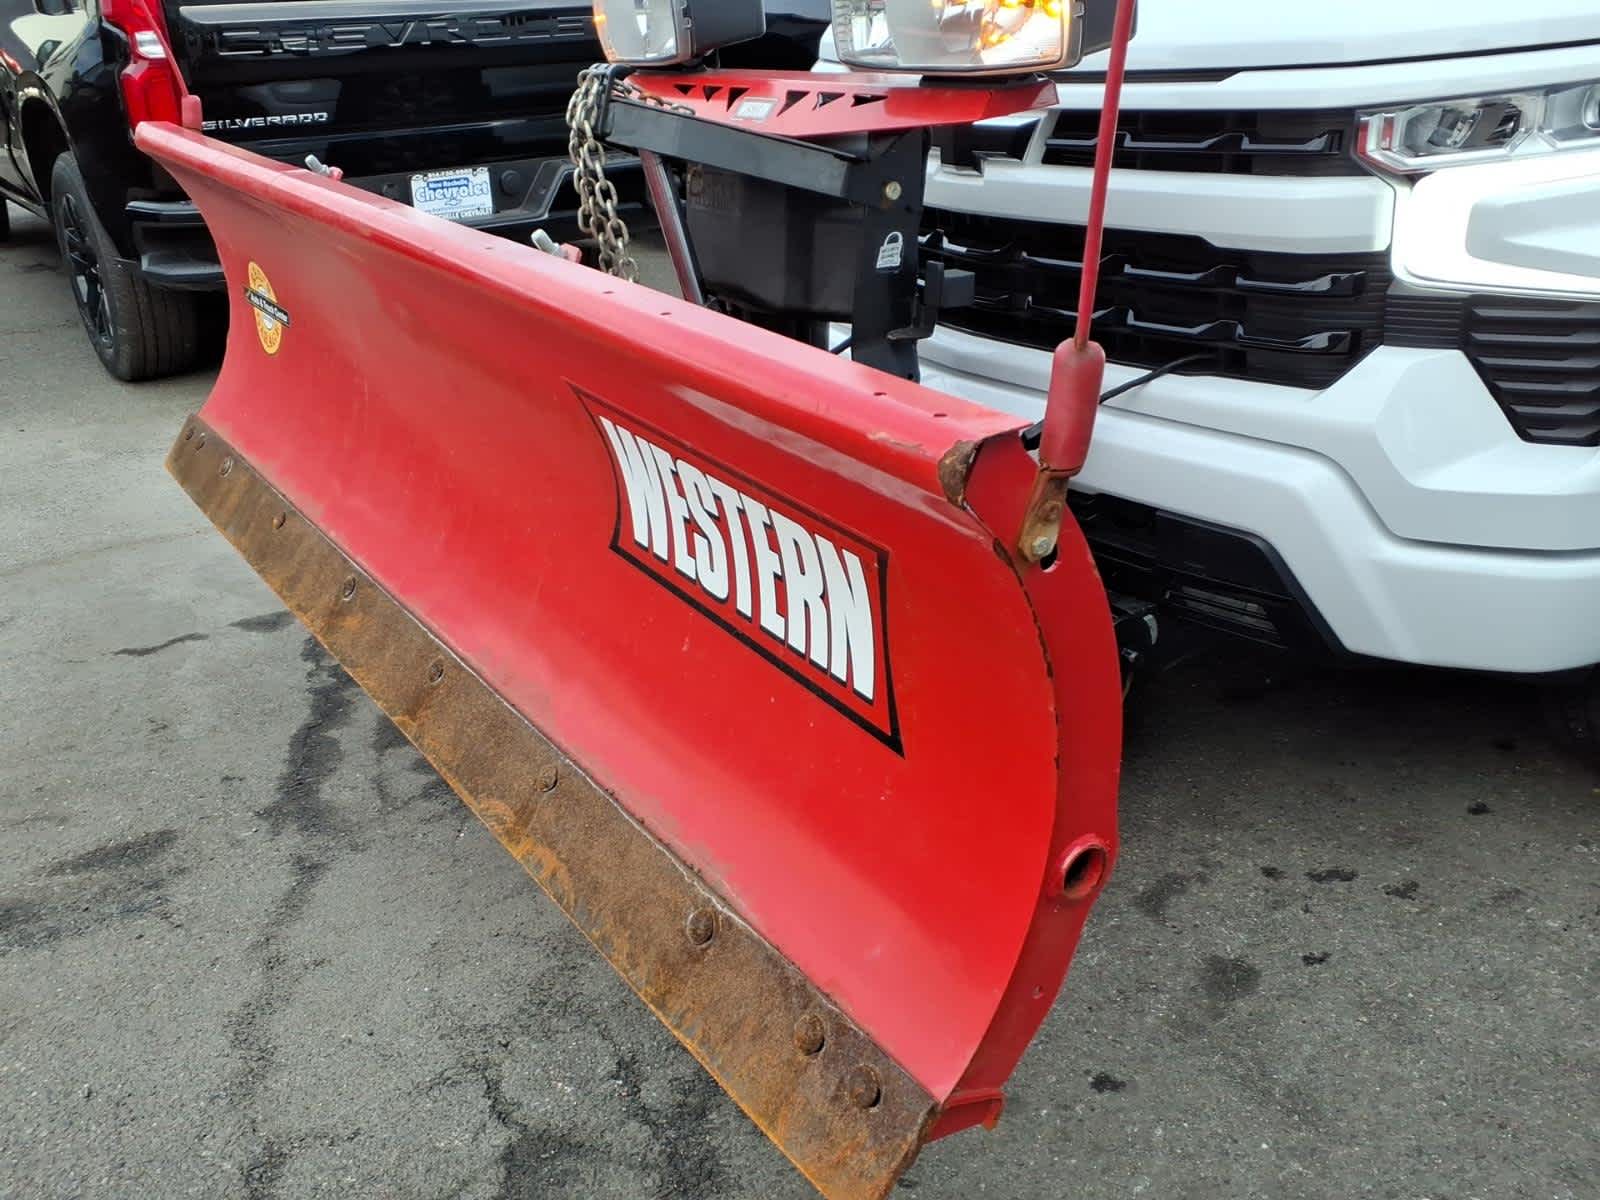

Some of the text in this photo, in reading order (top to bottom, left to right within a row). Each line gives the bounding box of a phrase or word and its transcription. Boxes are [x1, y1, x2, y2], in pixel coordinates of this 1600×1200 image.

[218, 14, 594, 55] CHEVROLE
[201, 112, 328, 130] SILVERADO
[415, 181, 489, 202] Chevrolet
[599, 415, 874, 703] WESTERN
